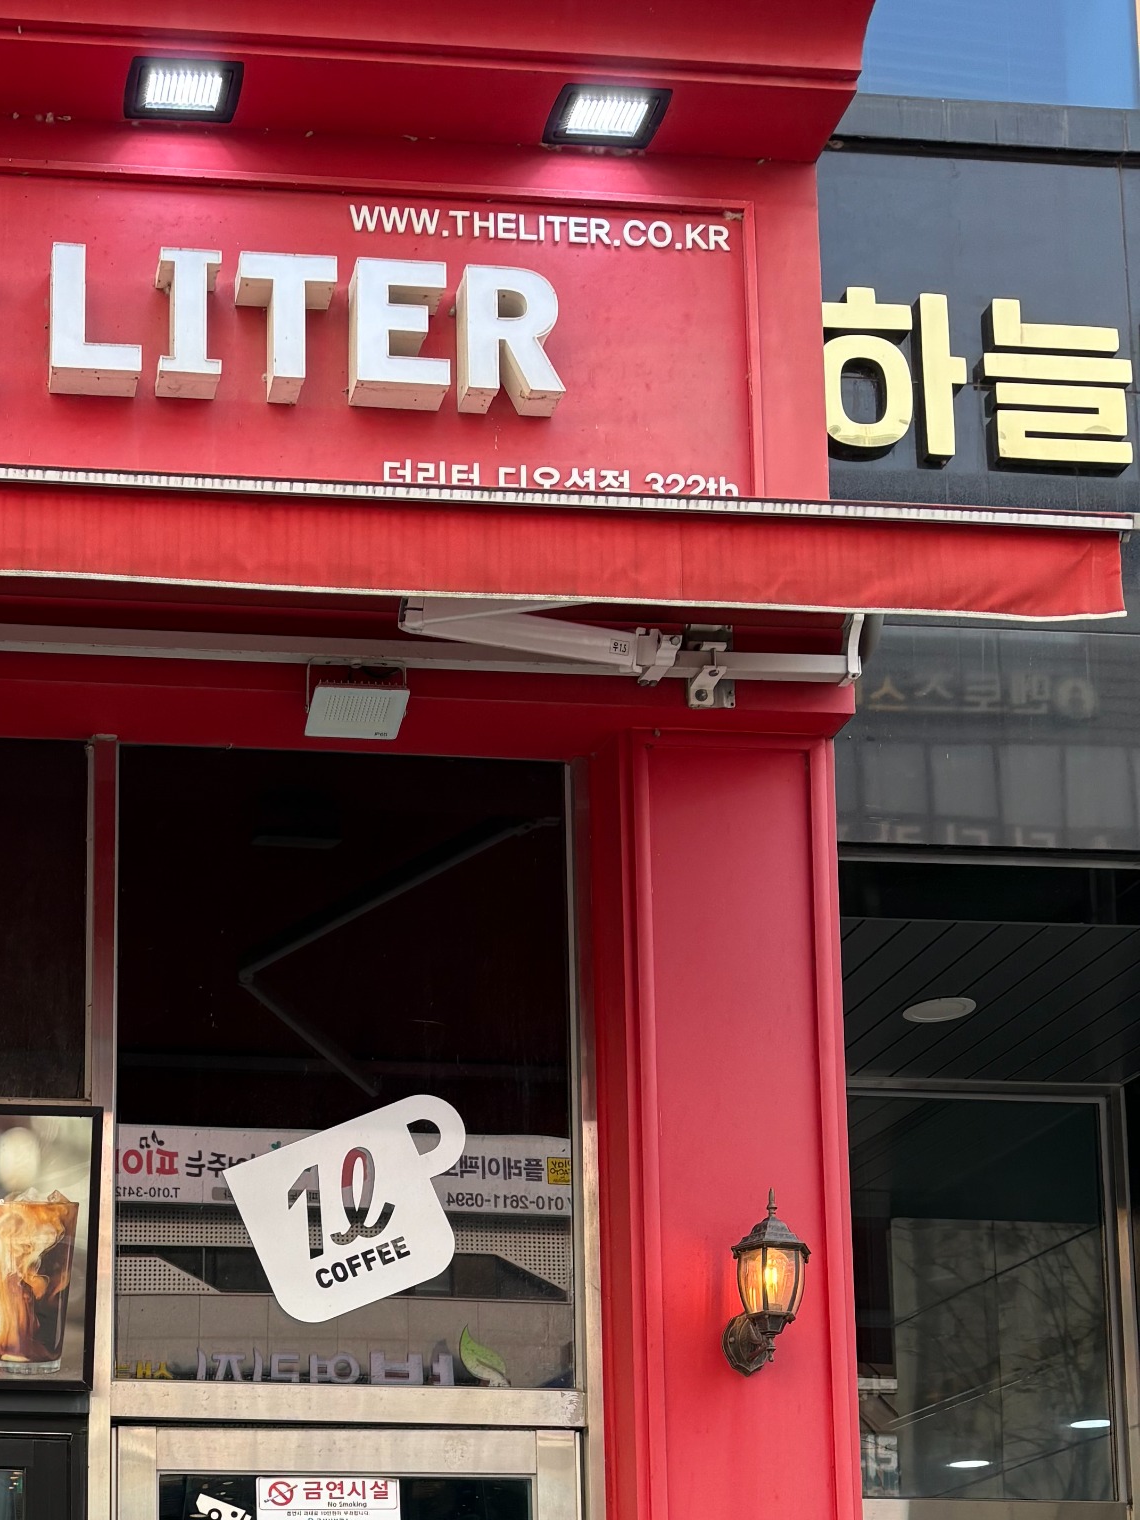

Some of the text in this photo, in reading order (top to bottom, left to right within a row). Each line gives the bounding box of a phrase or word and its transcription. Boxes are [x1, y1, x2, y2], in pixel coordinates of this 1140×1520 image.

[349, 204, 731, 252] WWW.THELITER.CO.KR
[49, 240, 566, 412] LITER
[821, 286, 1133, 464] 하늘
[383, 459, 480, 485] 더리터
[315, 1236, 411, 1289] COFFEE
[303, 1480, 389, 1500] 금연시설
